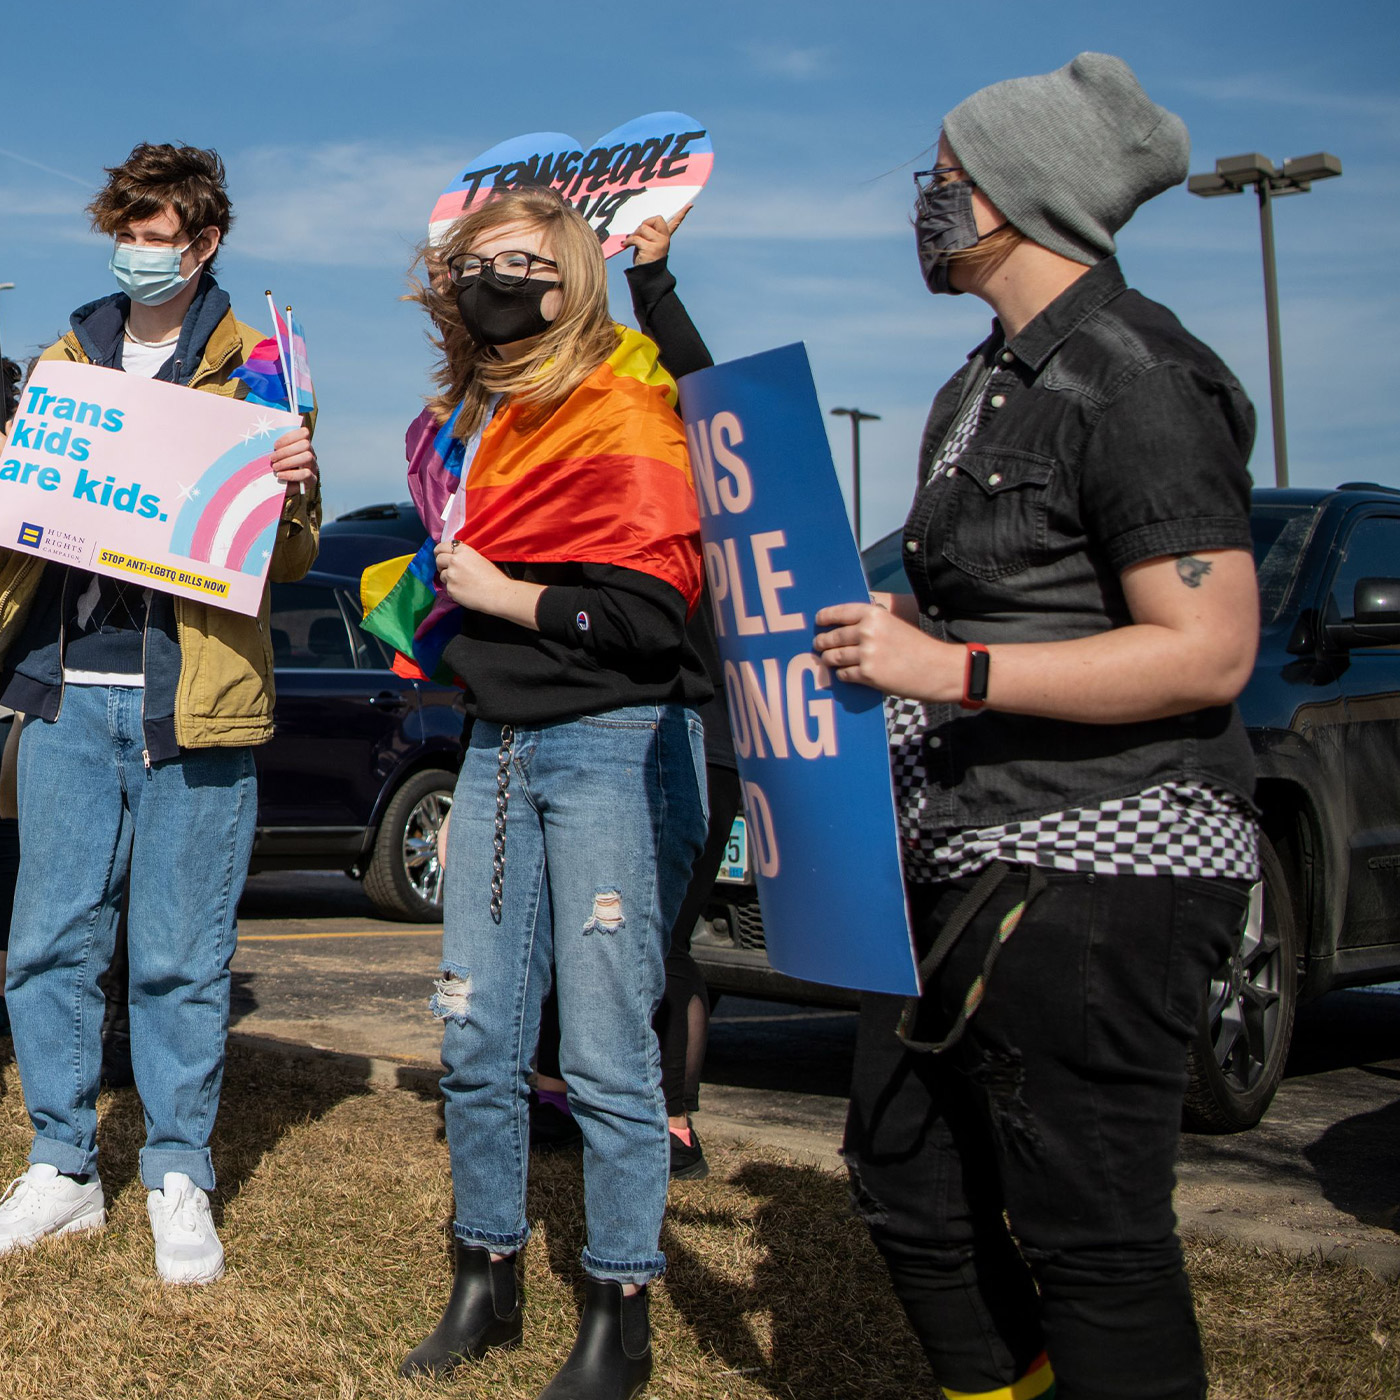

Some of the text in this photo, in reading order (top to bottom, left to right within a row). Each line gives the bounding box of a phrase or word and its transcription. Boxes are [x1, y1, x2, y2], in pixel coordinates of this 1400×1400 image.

[26, 386, 126, 433] Trans
[11, 419, 92, 462] kids
[0, 458, 168, 523] are kids.
[45, 538, 82, 553] RIGHTS
[47, 529, 85, 544] HUMAN
[101, 552, 227, 594] STOP ANTI-LGBTQ BILLS NOW
